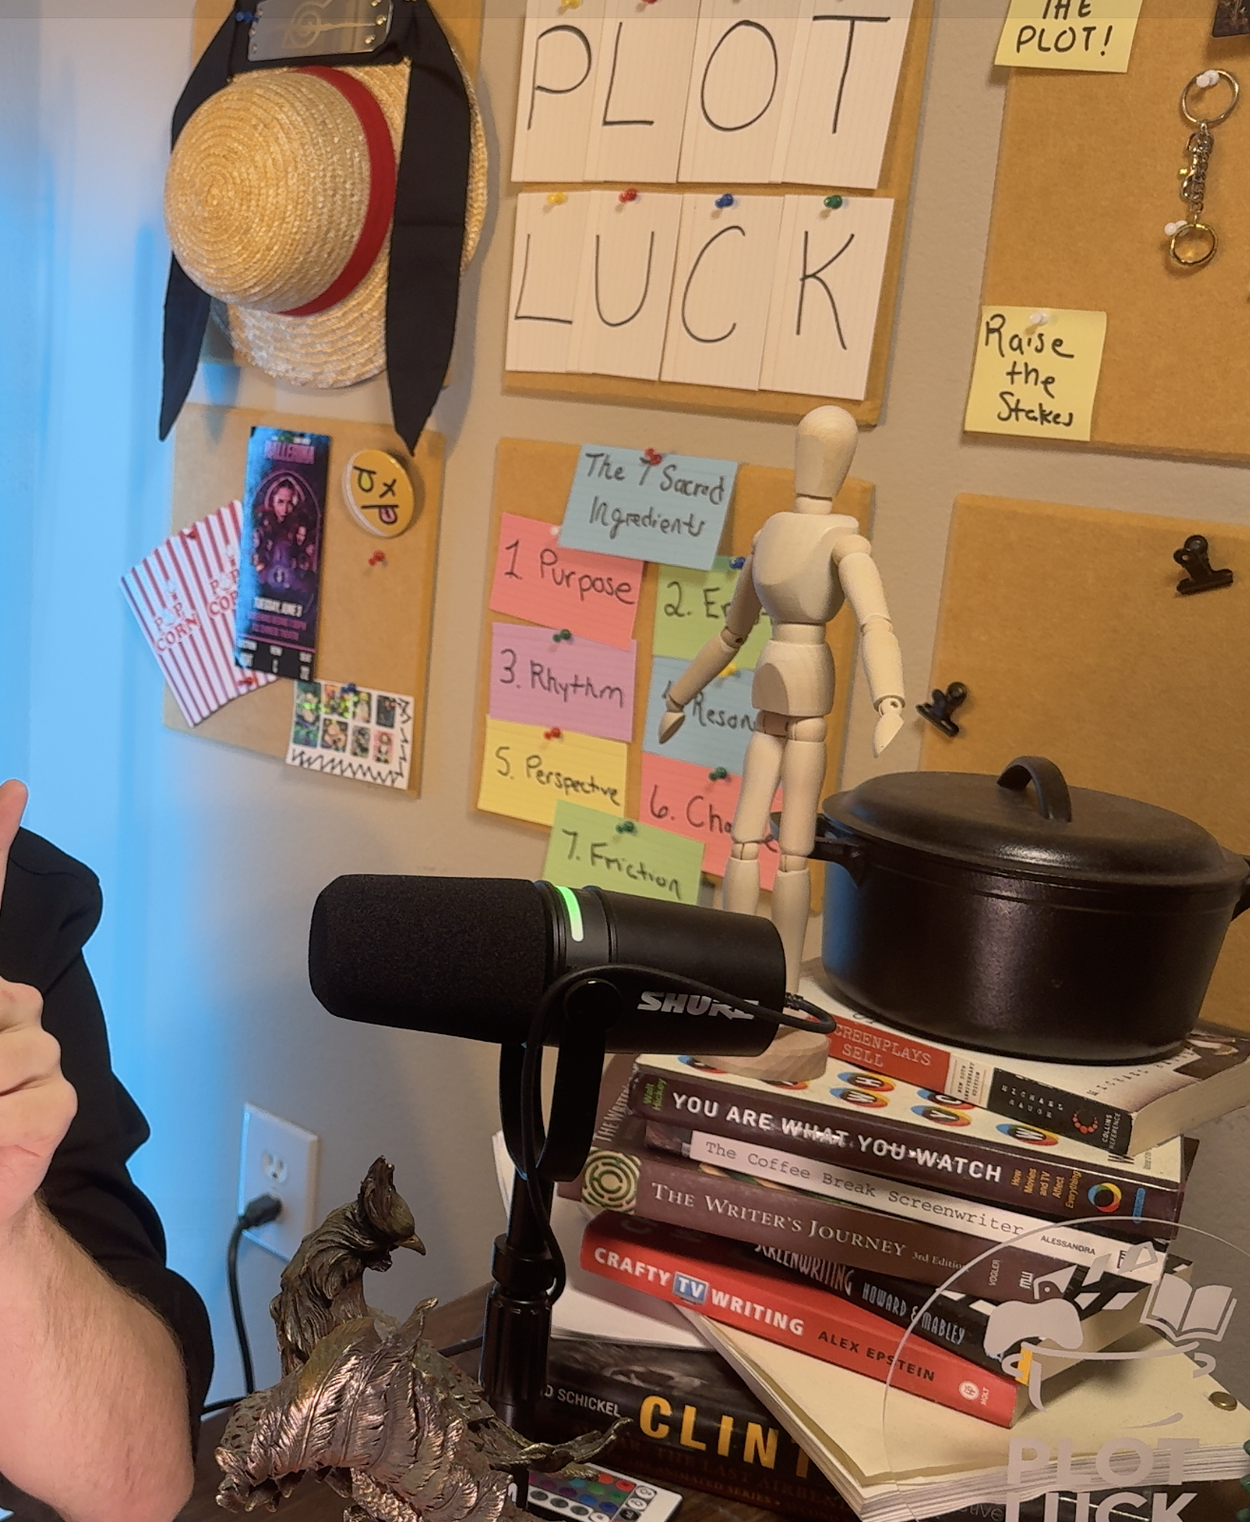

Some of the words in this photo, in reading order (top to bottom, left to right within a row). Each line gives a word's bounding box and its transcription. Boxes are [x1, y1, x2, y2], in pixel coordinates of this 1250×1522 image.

[1016, 25, 1113, 57] PLOT!
[527, 14, 892, 135] PLOT
[515, 224, 855, 350] LUCK
[985, 313, 1075, 358] Raise
[1006, 360, 1056, 399] the
[997, 391, 1073, 427] Stakes
[586, 452, 626, 481] The
[639, 457, 652, 486] 7
[660, 464, 725, 505] Sacred
[589, 496, 706, 540] Ingredients
[504, 539, 523, 580] 1
[539, 548, 636, 606] Purpose
[664, 581, 693, 618] 2.
[155, 613, 199, 652] CORN
[500, 649, 521, 689] 3.
[529, 659, 625, 708] Rhythm
[494, 746, 515, 780] 5.
[525, 755, 621, 807] Perspective
[650, 784, 675, 821] 6.
[686, 795, 778, 853] Chae
[562, 828, 581, 861] 7.
[589, 842, 682, 901] Friction
[833, 1023, 932, 1067] CREENPLAYS
[842, 1043, 885, 1068] SELL
[672, 1091, 720, 1119] YOU
[726, 1105, 775, 1131] ARE
[781, 1117, 850, 1148] WHAT
[857, 1134, 907, 1161] YOU
[915, 1147, 1003, 1184] WATCH
[1101, 1113, 1113, 1144] COLLINS
[1108, 1111, 1122, 1150] REFERENCE
[705, 1140, 737, 1160] The
[747, 1153, 810, 1180] Coffee
[822, 1172, 876, 1198] Break
[888, 1190, 1024, 1236] Screenwriter
[1010, 1168, 1022, 1187] How
[1023, 1167, 1038, 1195] Movies
[1052, 1176, 1066, 1199] Affect
[1065, 1170, 1083, 1209] Everything
[652, 1182, 695, 1208] THE
[705, 1195, 803, 1233] WRITER'S
[808, 1219, 908, 1259] JOURNEY
[911, 1251, 930, 1264] 3rd
[1041, 1235, 1097, 1256] ALESSANDRA
[594, 1247, 671, 1287] CRAFTY
[677, 1276, 706, 1299] TV
[710, 1288, 805, 1337] WRITING
[988, 1259, 1000, 1287] VOGLER
[862, 1282, 907, 1318] HOWARD
[921, 1311, 966, 1346] MABLEY
[818, 1330, 860, 1354] ALEX
[866, 1347, 936, 1382] EPSTEIN
[557, 1387, 622, 1418] SCHICKEL
